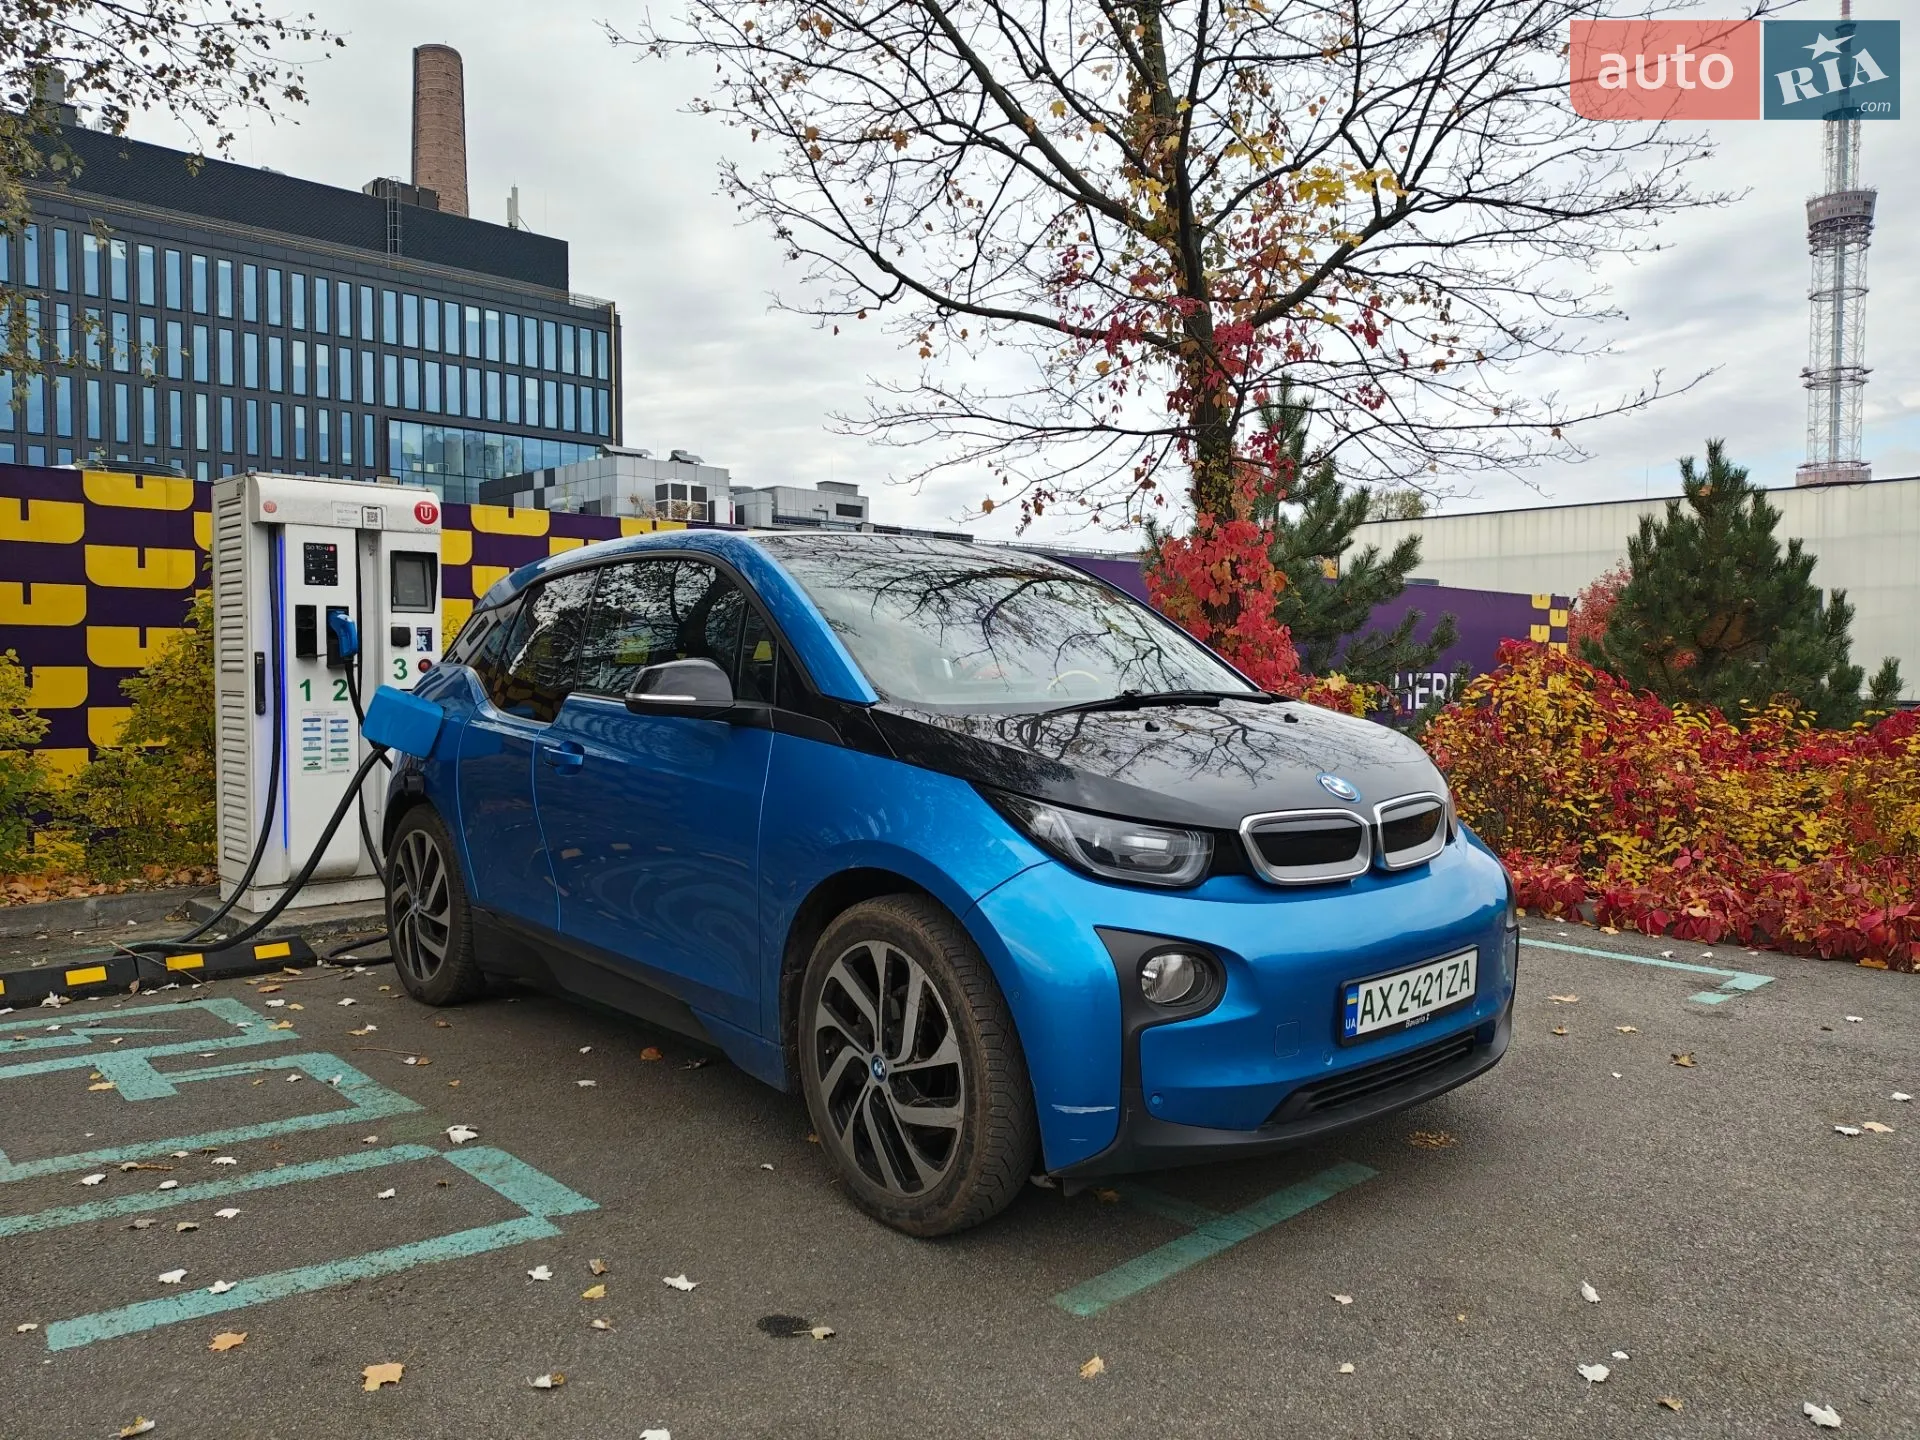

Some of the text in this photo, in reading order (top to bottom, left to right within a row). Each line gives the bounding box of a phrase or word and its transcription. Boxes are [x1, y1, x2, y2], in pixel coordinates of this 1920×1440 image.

[393, 658, 408, 680] 3
[300, 679, 348, 701] 1 2
[1360, 959, 1470, 1026] AX 2421 ZA
[1345, 1017, 1356, 1030] UA
